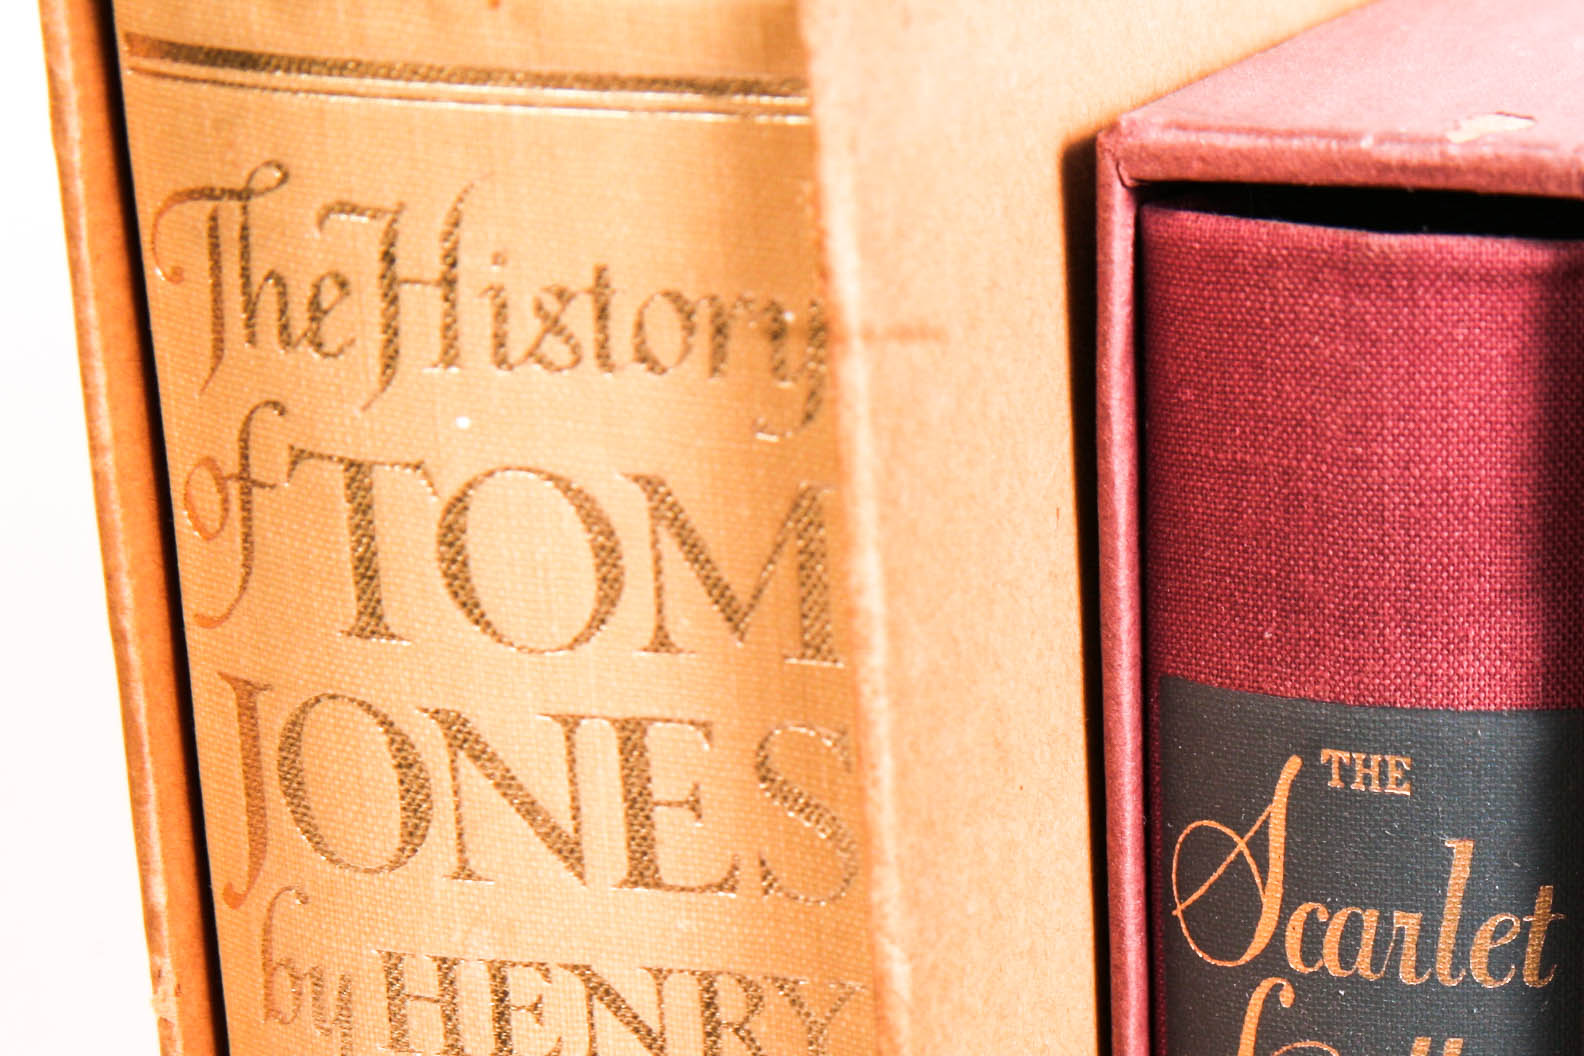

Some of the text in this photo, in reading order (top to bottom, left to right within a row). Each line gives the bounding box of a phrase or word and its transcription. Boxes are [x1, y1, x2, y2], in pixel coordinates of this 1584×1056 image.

[152, 159, 829, 441] The History
[184, 400, 845, 668] of TOM
[217, 672, 860, 910] JONES
[1172, 755, 1566, 988] Scarlet
[1321, 748, 1412, 796] THE
